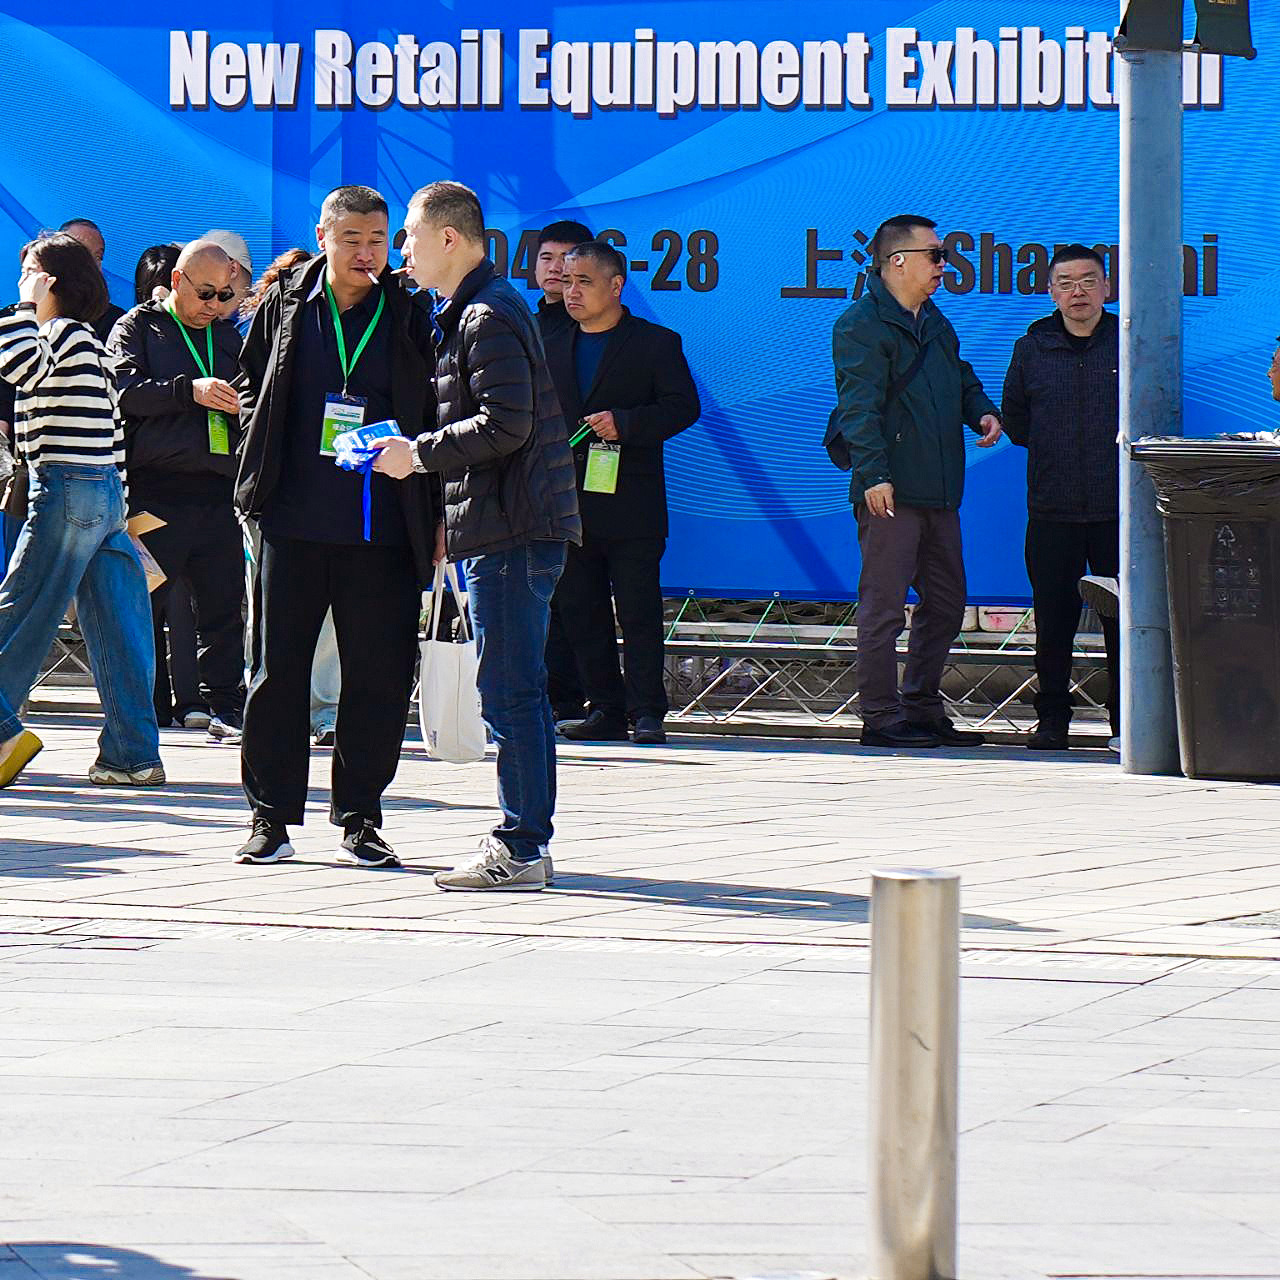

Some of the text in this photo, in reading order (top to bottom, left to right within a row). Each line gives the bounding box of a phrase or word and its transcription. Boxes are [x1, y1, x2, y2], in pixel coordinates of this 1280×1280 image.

[169, 29, 298, 109] New
[315, 29, 502, 111] Retail
[523, 27, 871, 119] Equipment
